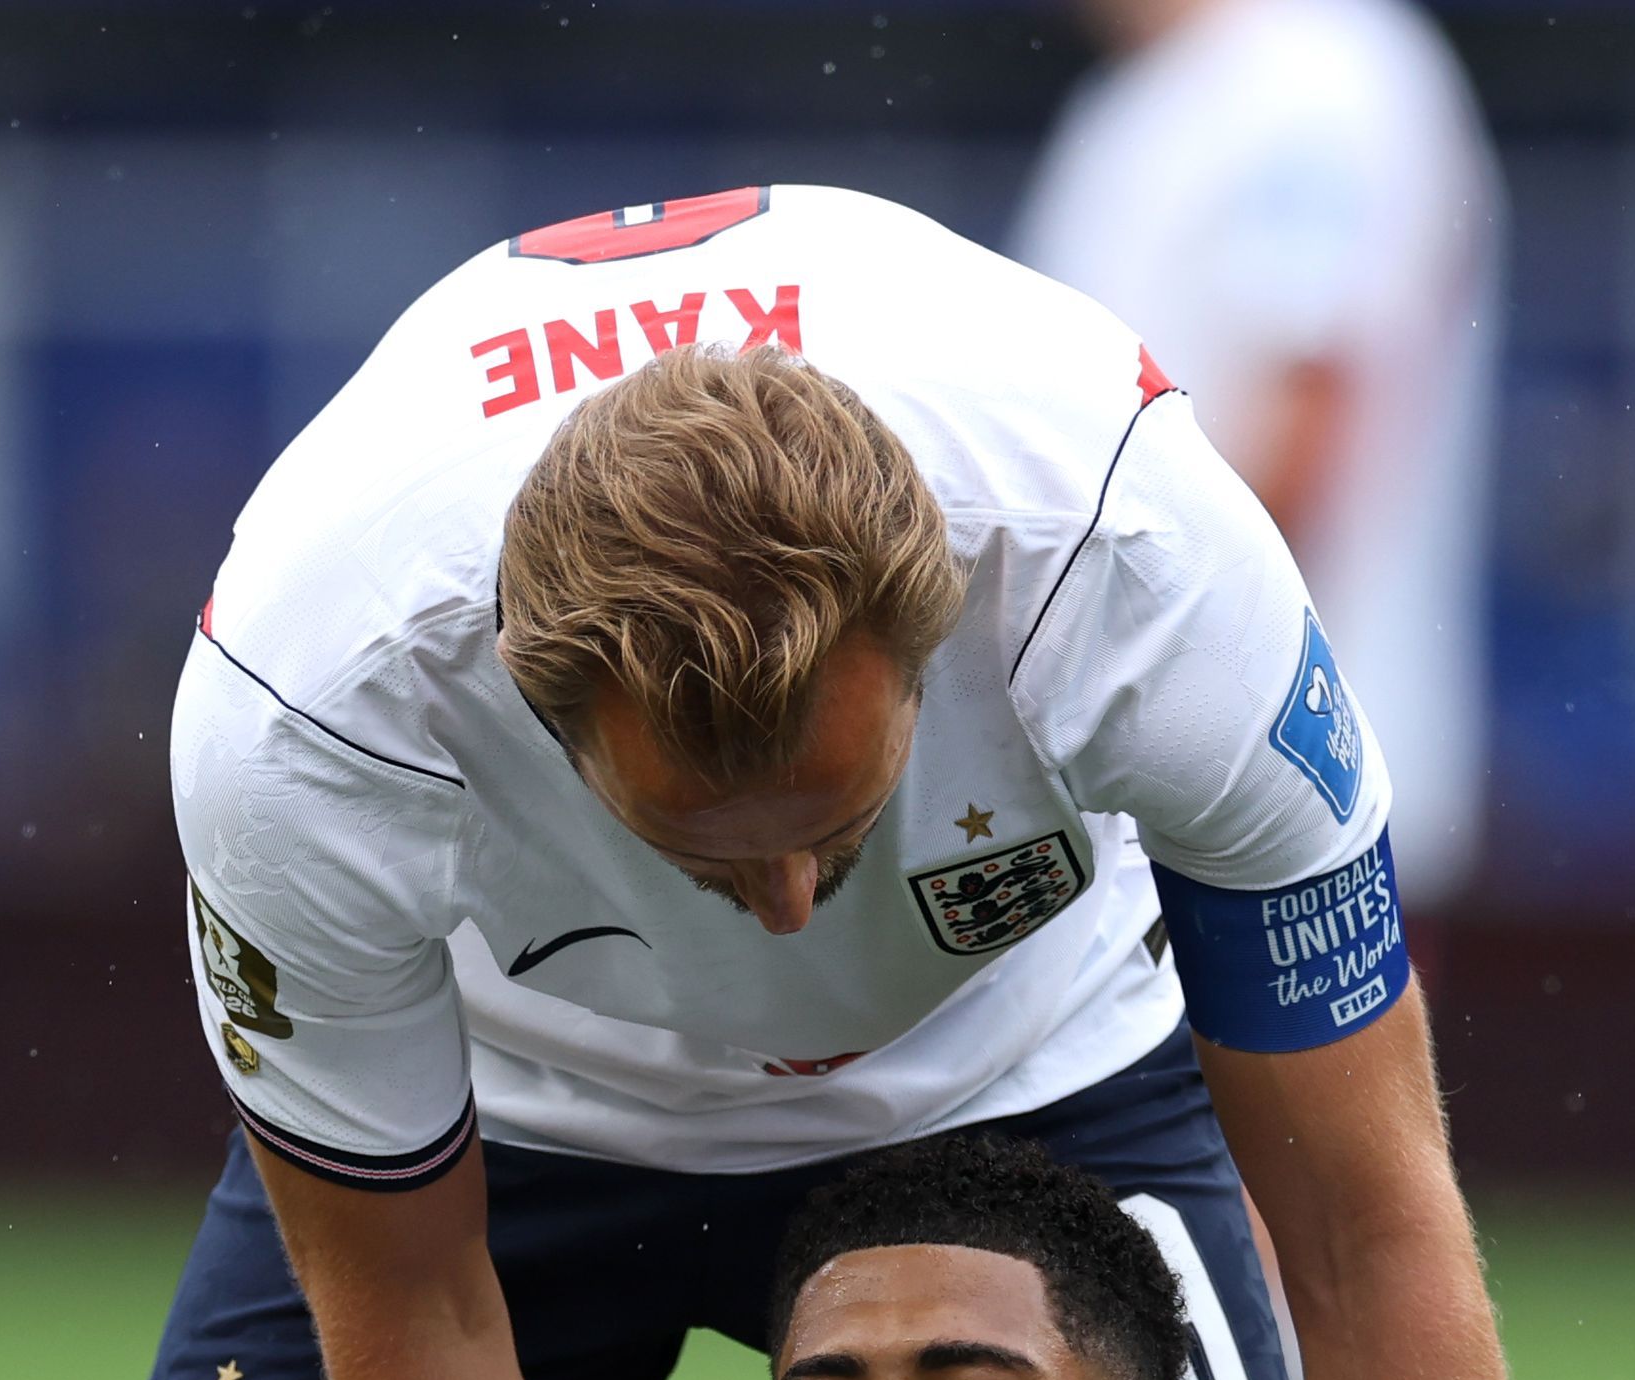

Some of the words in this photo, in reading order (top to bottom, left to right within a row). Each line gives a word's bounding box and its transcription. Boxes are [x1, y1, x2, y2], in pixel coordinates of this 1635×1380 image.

[470, 285, 802, 419] KANE
[1262, 843, 1383, 927] FOOTBALL
[1266, 871, 1390, 967] UNITES
[1268, 969, 1332, 1007] the
[1333, 905, 1401, 987] World
[1335, 982, 1383, 1020] FIFA
